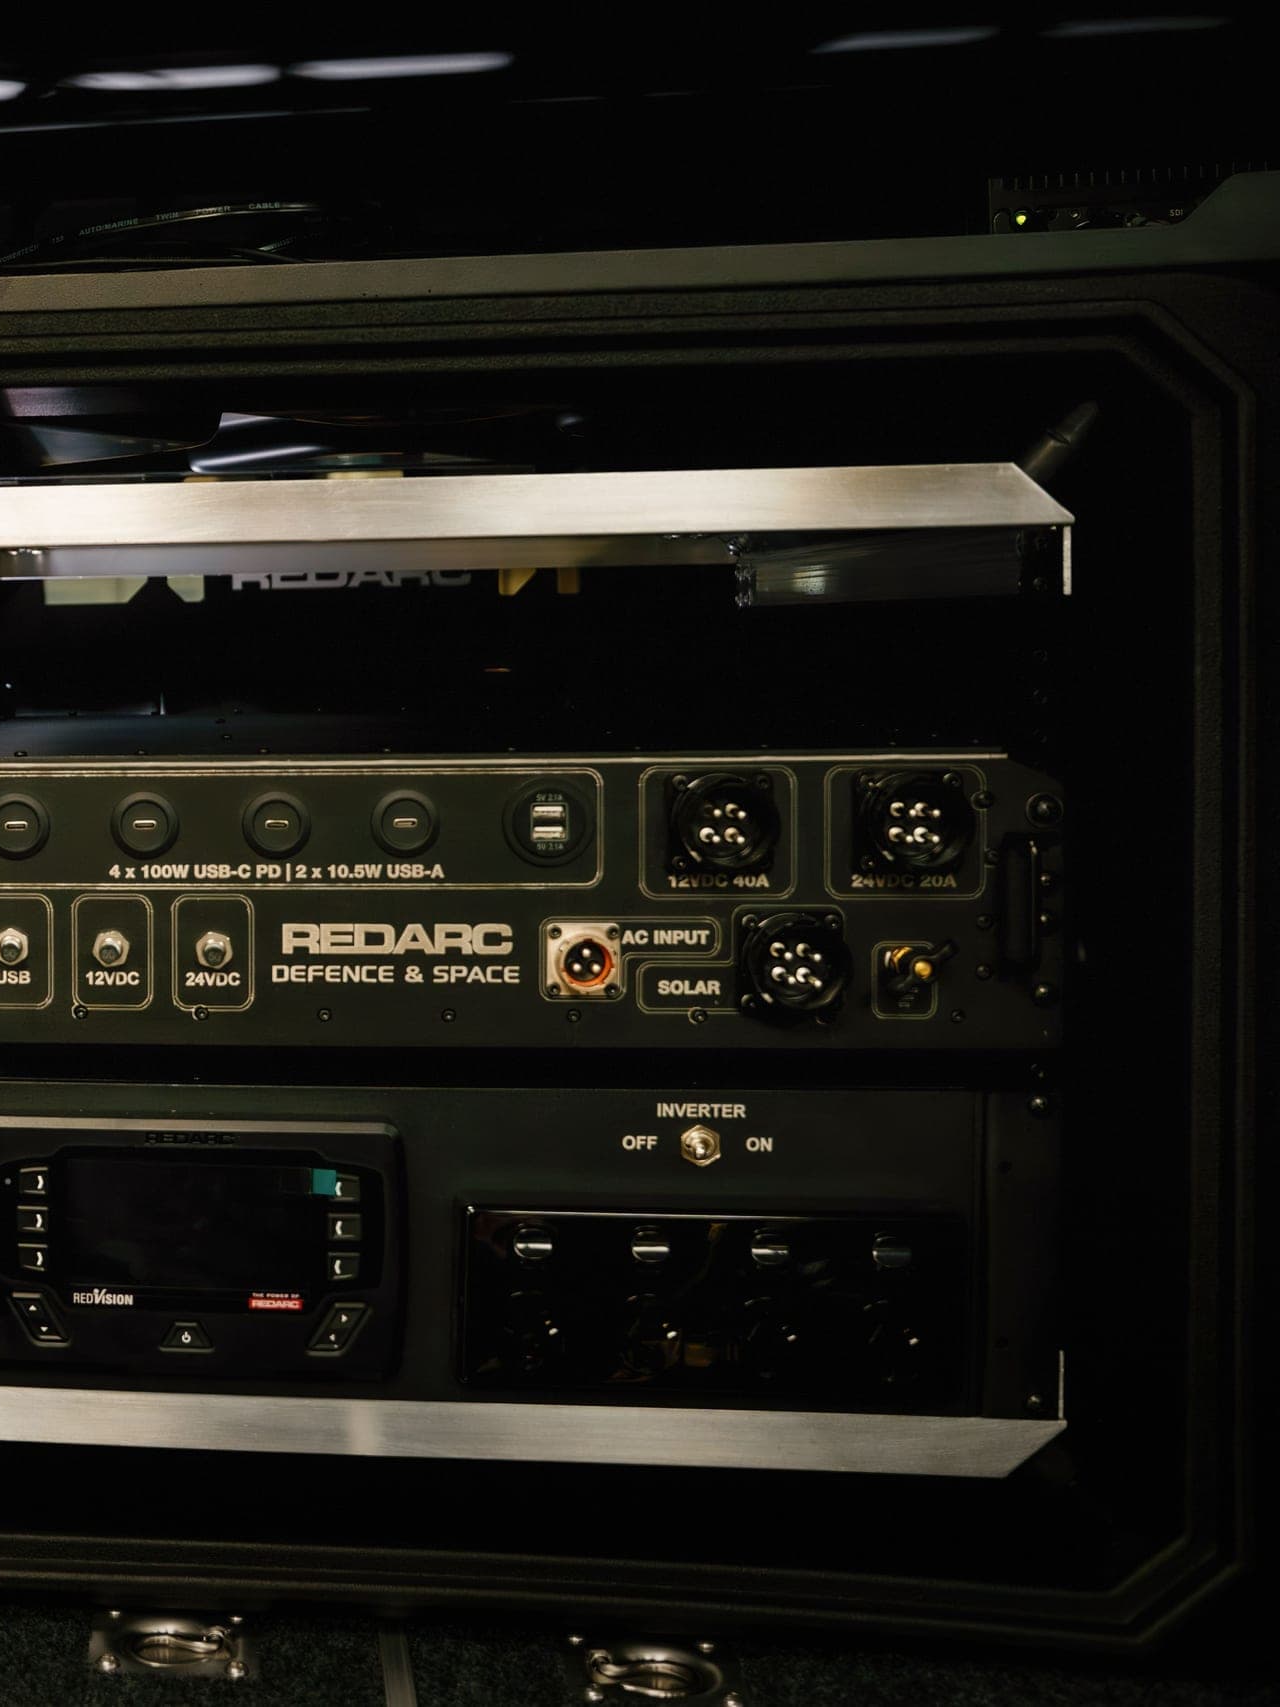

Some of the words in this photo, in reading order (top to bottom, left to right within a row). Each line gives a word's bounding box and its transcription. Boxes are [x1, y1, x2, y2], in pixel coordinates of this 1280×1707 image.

[248, 201, 281, 210] CABLE
[108, 864, 121, 879] 4
[124, 867, 136, 879] x
[140, 864, 189, 879] 100W
[193, 864, 251, 879] USB-C
[255, 864, 282, 879] PD
[295, 864, 308, 879] 2
[311, 867, 323, 879] x
[327, 863, 383, 879] 10.5W
[386, 863, 445, 879] USB-A
[667, 873, 729, 888] 12VDC
[732, 873, 770, 888] 40A
[850, 873, 915, 888] 24VDC
[919, 873, 957, 888] 20A
[281, 923, 514, 955] REDARC
[621, 929, 649, 945] AC
[652, 929, 710, 945] INPUT
[85, 971, 140, 986] 12VDC
[185, 972, 240, 987] 24VDC
[272, 965, 395, 983] DEFENCE
[404, 965, 425, 984] &
[432, 965, 521, 984] SPACE
[657, 979, 721, 996] SOLAR
[656, 1103, 747, 1119] INVERTER
[145, 1132, 239, 1145] REDARC
[621, 1135, 659, 1151] OFF
[744, 1136, 773, 1152] ON
[73, 1288, 134, 1306] REDVISION
[252, 1300, 300, 1309] REDARC
